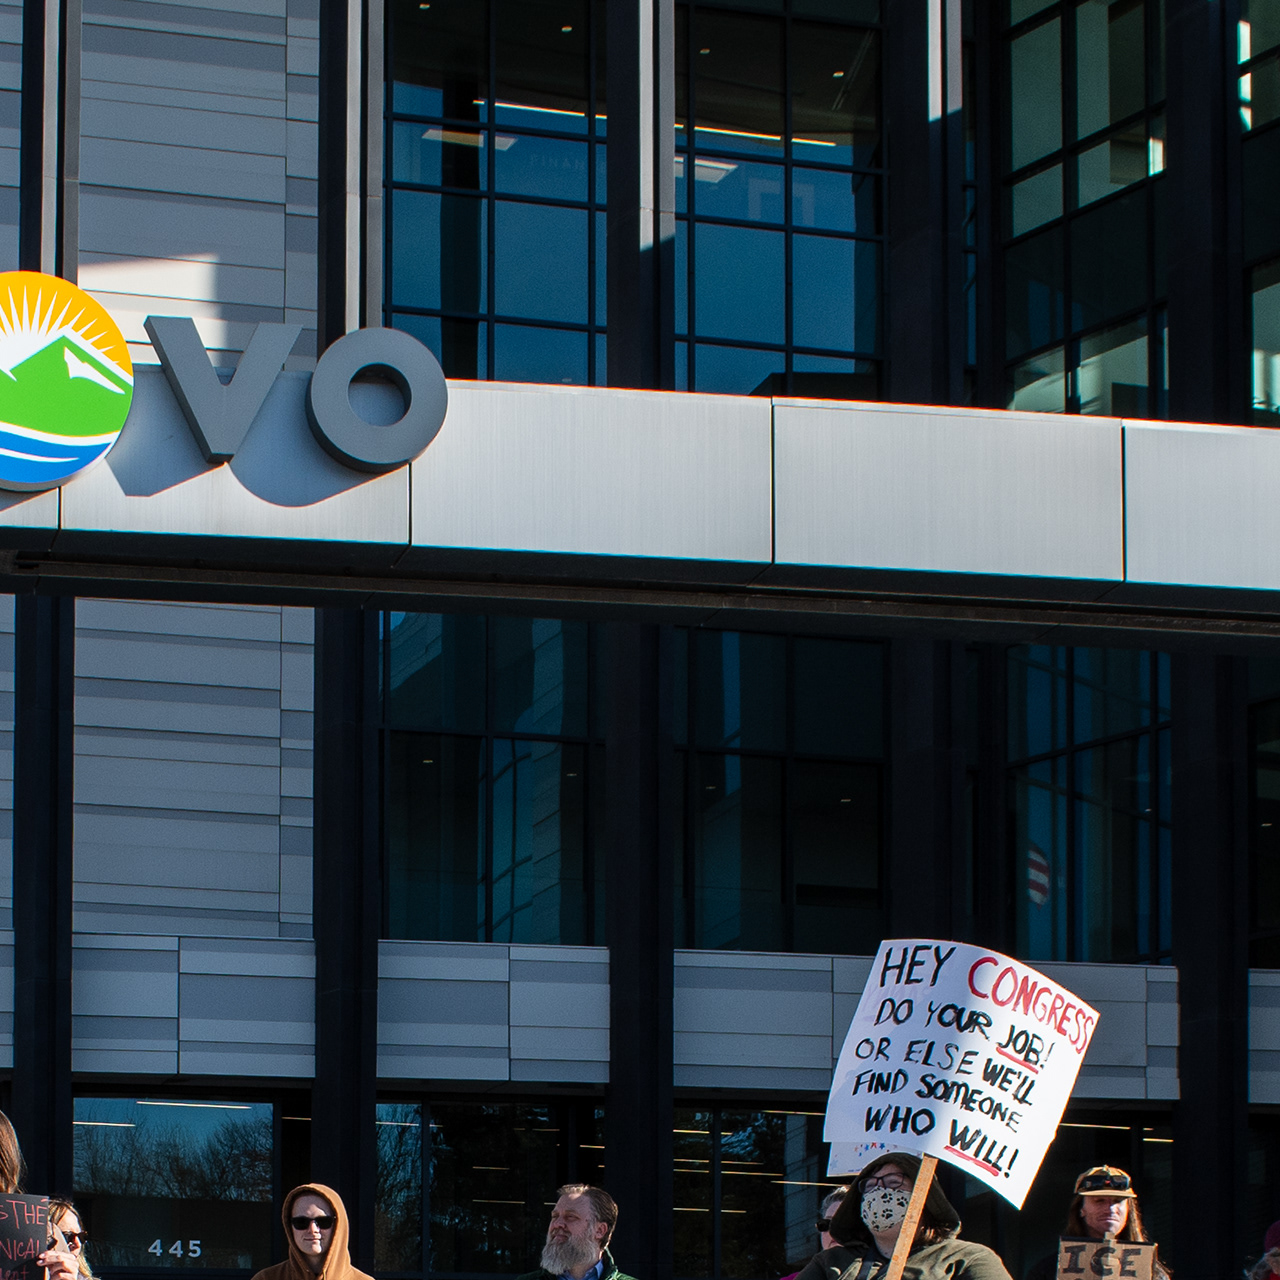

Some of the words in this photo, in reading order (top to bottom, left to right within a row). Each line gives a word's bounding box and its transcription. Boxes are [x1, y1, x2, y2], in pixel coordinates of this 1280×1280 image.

[879, 944, 957, 988] HEY
[968, 956, 1094, 1055] CONGRESS
[873, 997, 914, 1027] DO
[925, 1000, 993, 1042] YOUR
[996, 1024, 1056, 1070] JOB!
[852, 1069, 909, 1097] FIND
[855, 1036, 891, 1062] OR
[903, 1038, 979, 1075] ELSE
[981, 1058, 1036, 1106] WE'LL
[864, 1103, 936, 1136] WHO
[949, 1118, 1019, 1179] WILL!
[6, 1198, 49, 1230] THE
[147, 1238, 202, 1258] 445
[1062, 1243, 1142, 1278] ICE
